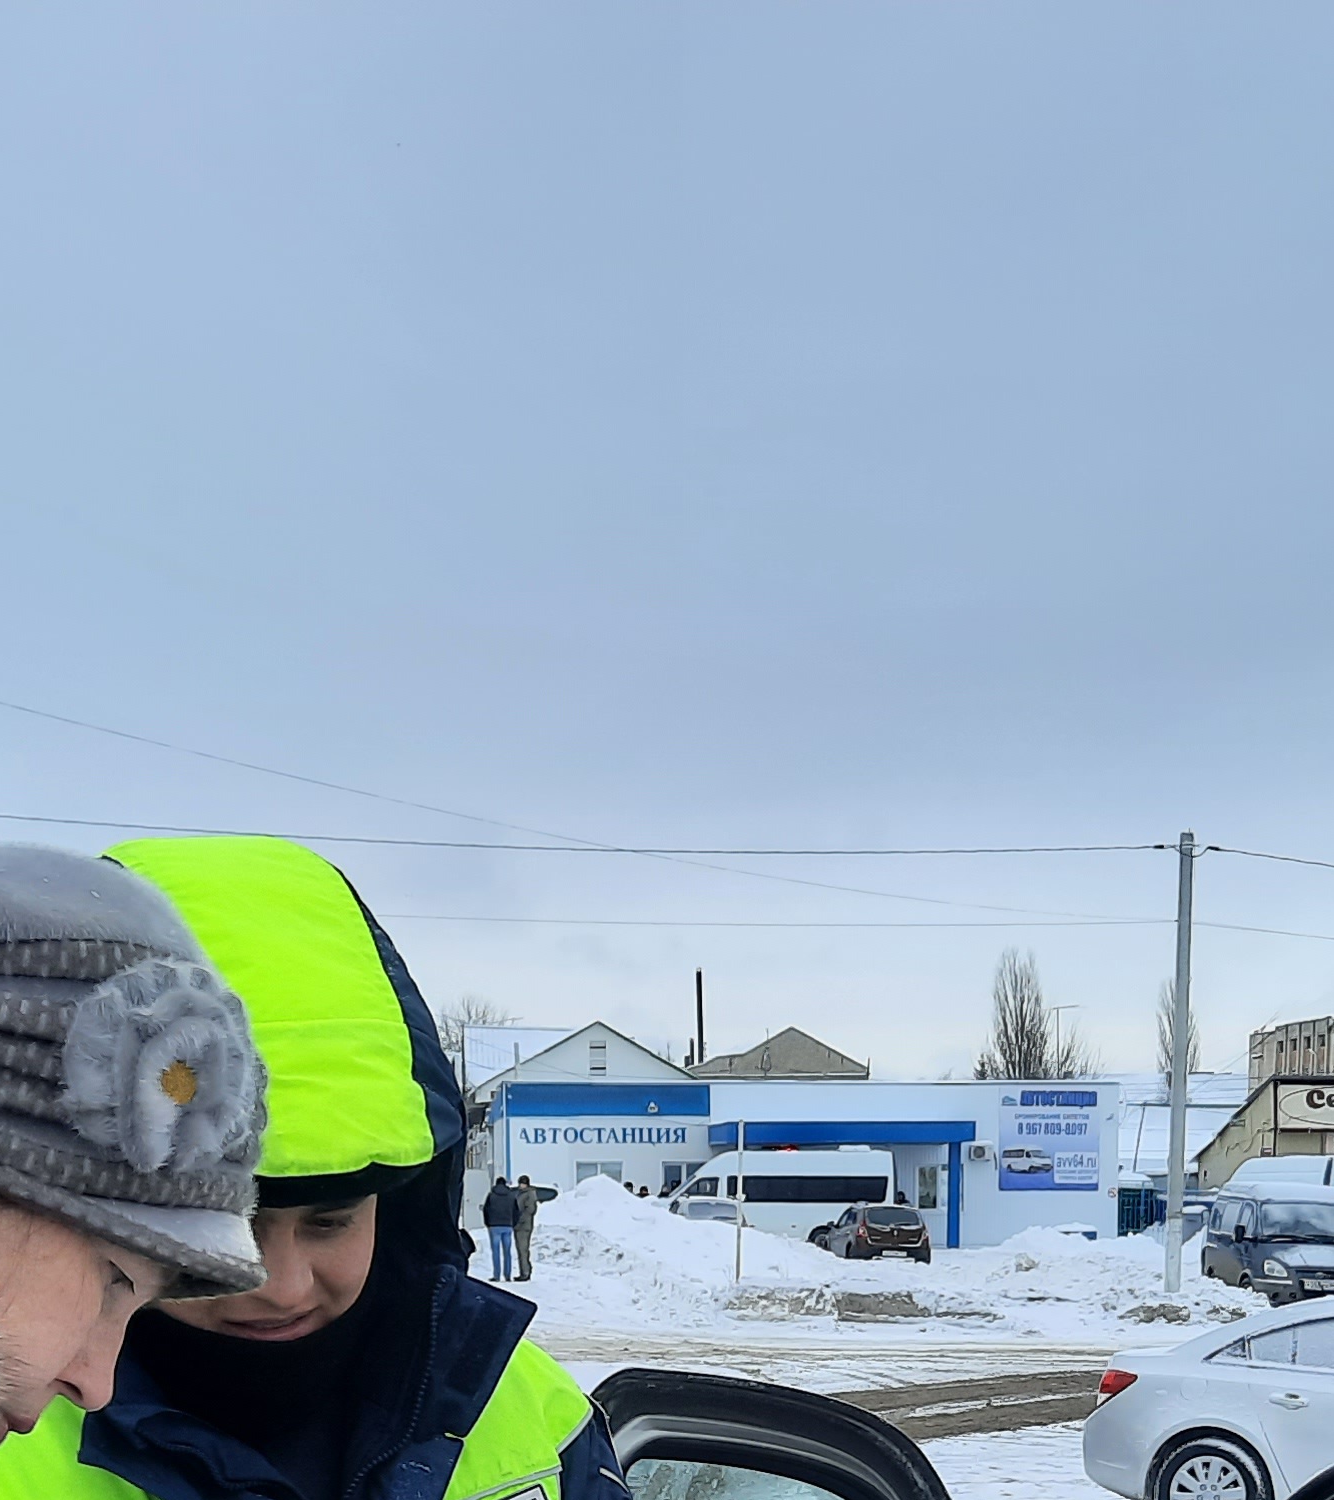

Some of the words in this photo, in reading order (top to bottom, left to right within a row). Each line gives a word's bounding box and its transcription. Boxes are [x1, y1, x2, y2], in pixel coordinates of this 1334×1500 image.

[1018, 1122, 1024, 1135] 8
[519, 1127, 687, 1146] АВТОСТАНЦИЯ
[1056, 1154, 1097, 1169] avv64.ru
